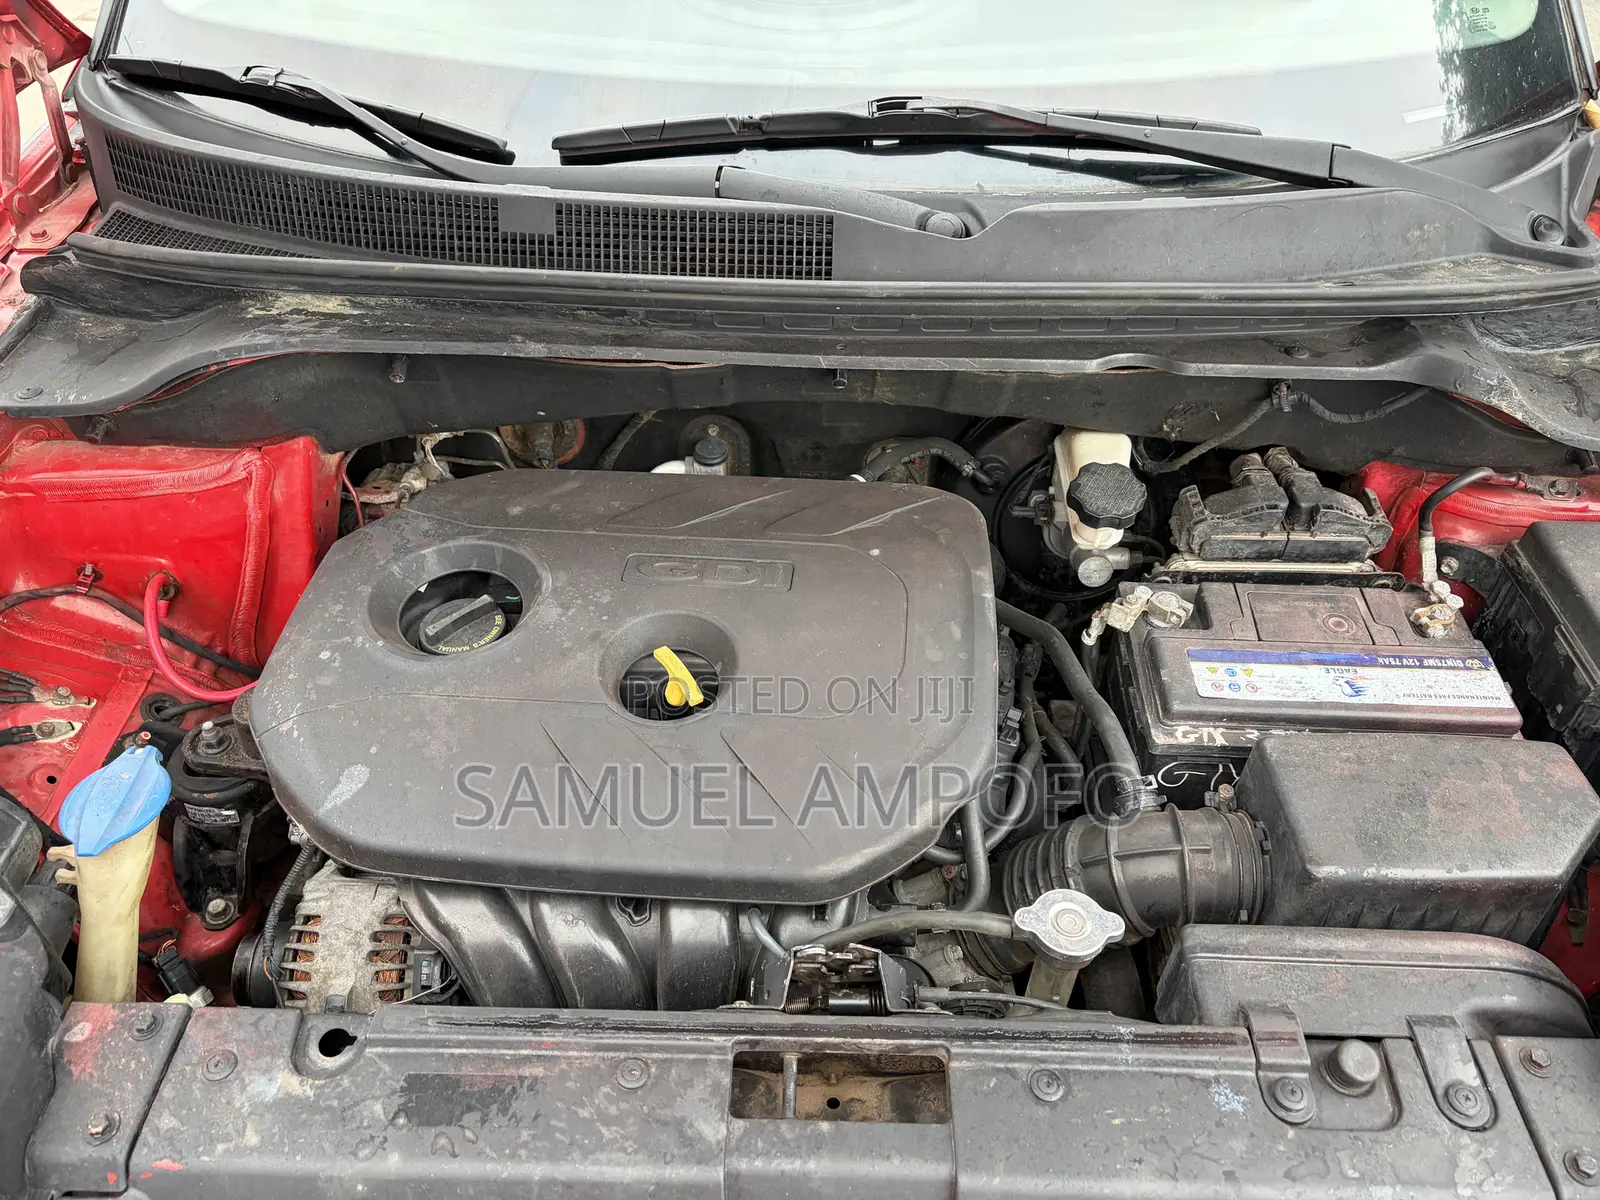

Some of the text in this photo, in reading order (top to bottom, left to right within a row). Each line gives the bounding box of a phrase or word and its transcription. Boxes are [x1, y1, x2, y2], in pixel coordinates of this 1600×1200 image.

[439, 644, 469, 652] MANUAL
[1377, 656, 1402, 667] 75Ah
[1402, 657, 1420, 667] 12V
[1325, 667, 1358, 675] EAGLE
[1451, 692, 1501, 701] MAINTENANCE
